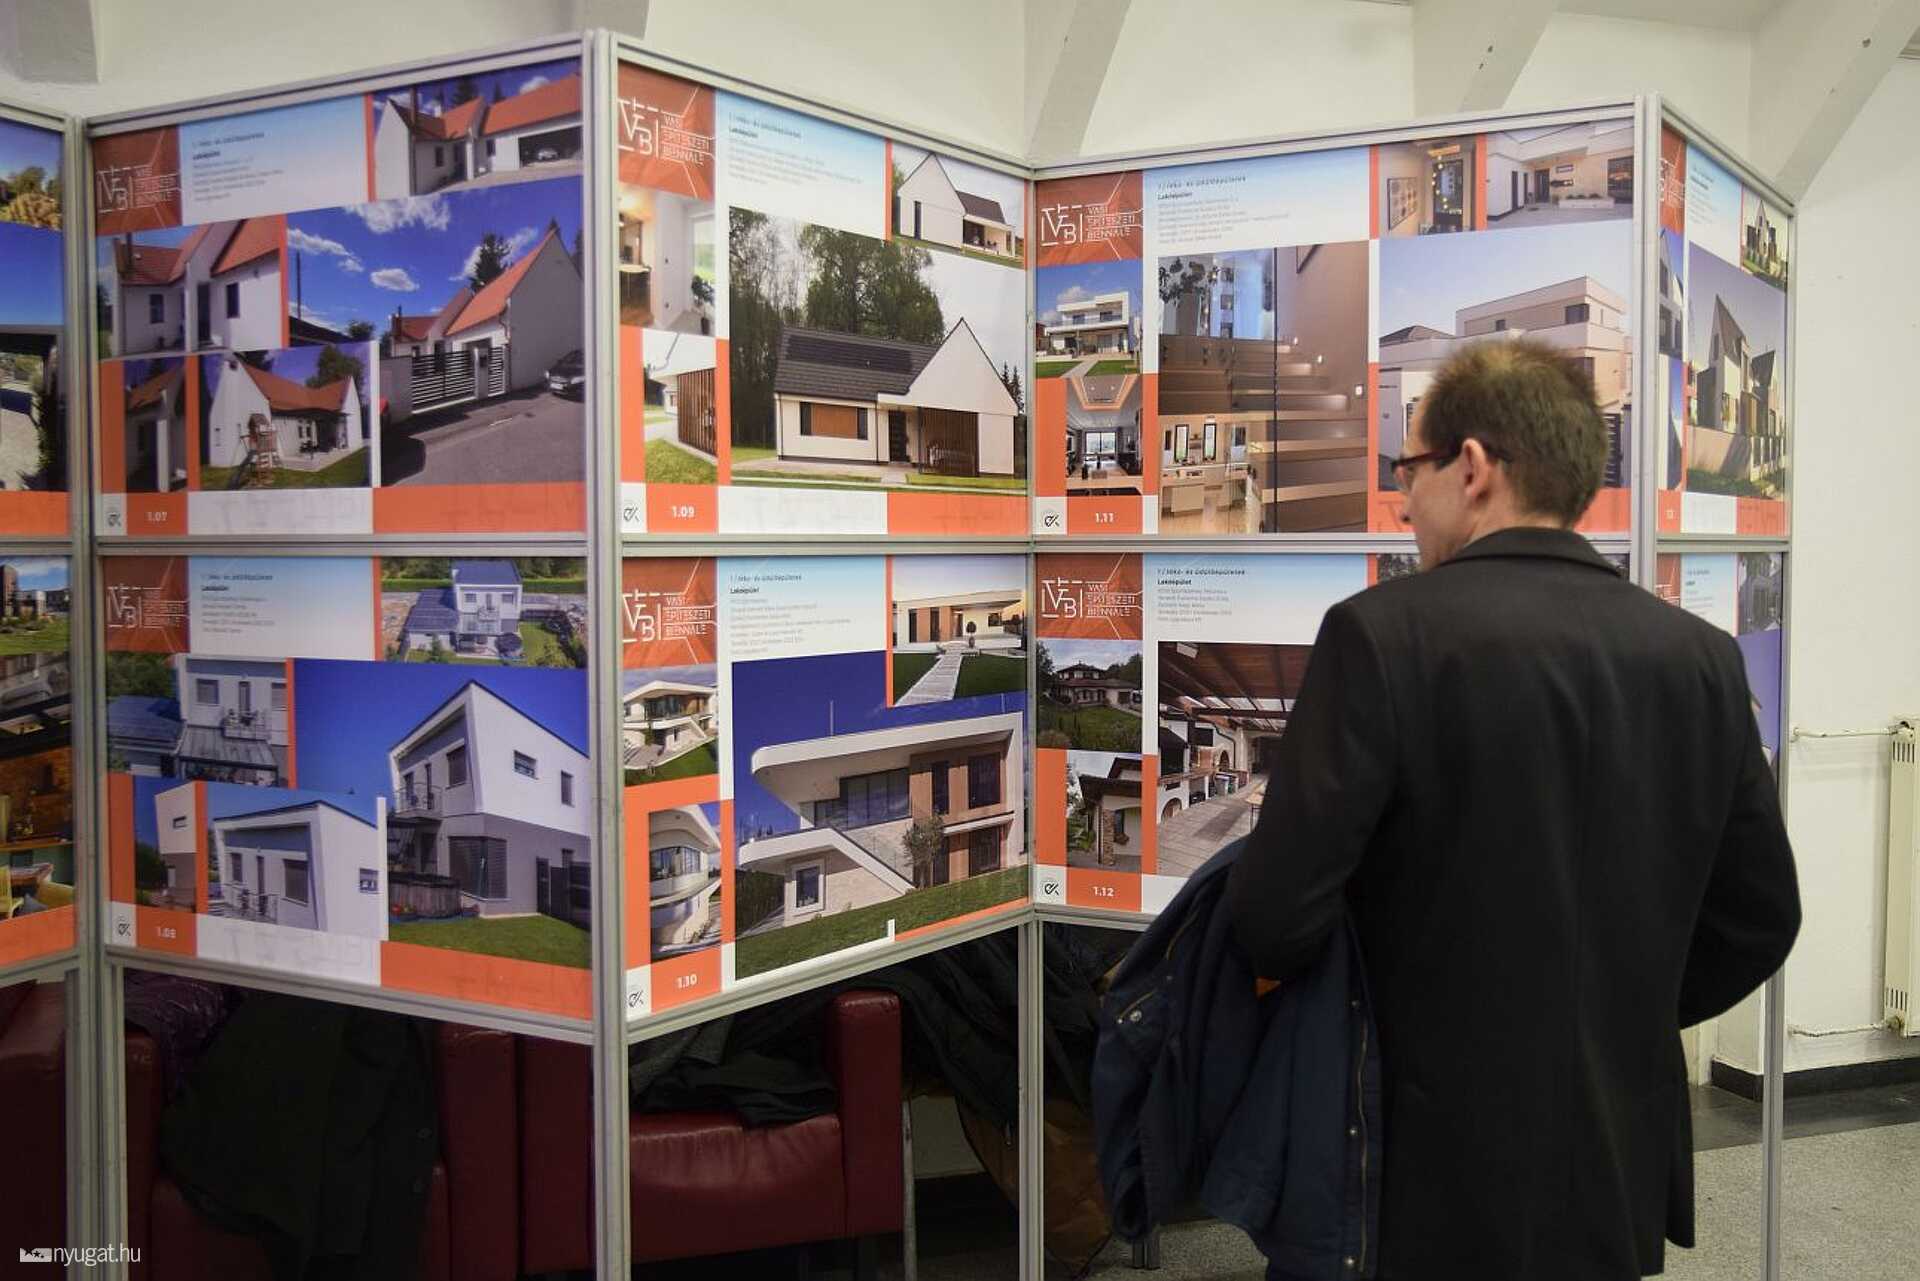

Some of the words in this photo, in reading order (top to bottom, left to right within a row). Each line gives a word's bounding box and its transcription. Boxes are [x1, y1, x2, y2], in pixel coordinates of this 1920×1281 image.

[671, 505, 695, 518] 1.09
[1092, 886, 1115, 897] 1.12
[676, 973, 698, 989] 1.10
